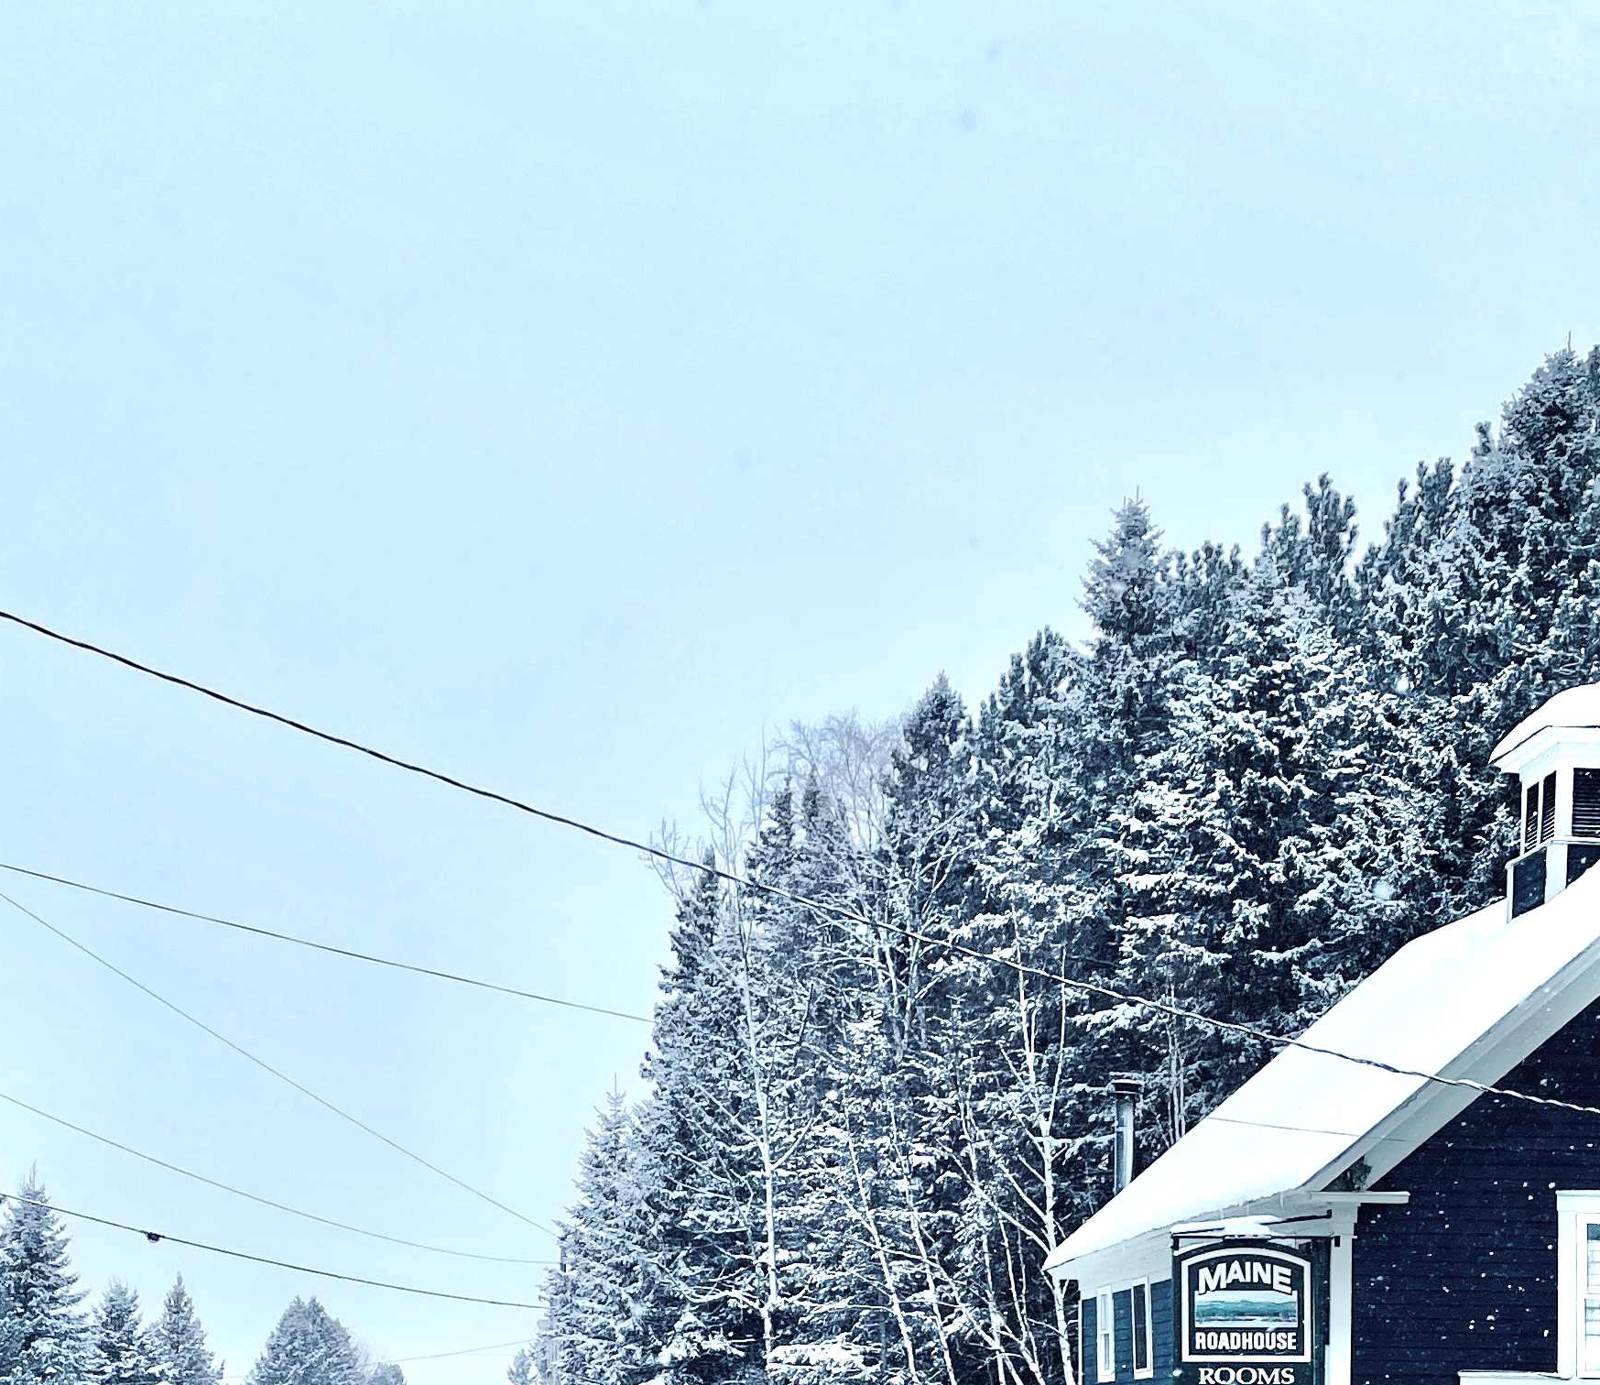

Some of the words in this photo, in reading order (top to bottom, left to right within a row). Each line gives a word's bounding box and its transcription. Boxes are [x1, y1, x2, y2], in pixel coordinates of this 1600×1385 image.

[1198, 1260, 1293, 1295] MAINE
[1195, 1331, 1297, 1350] ROADHOUSE
[1198, 1367, 1295, 1385] ROOMS
